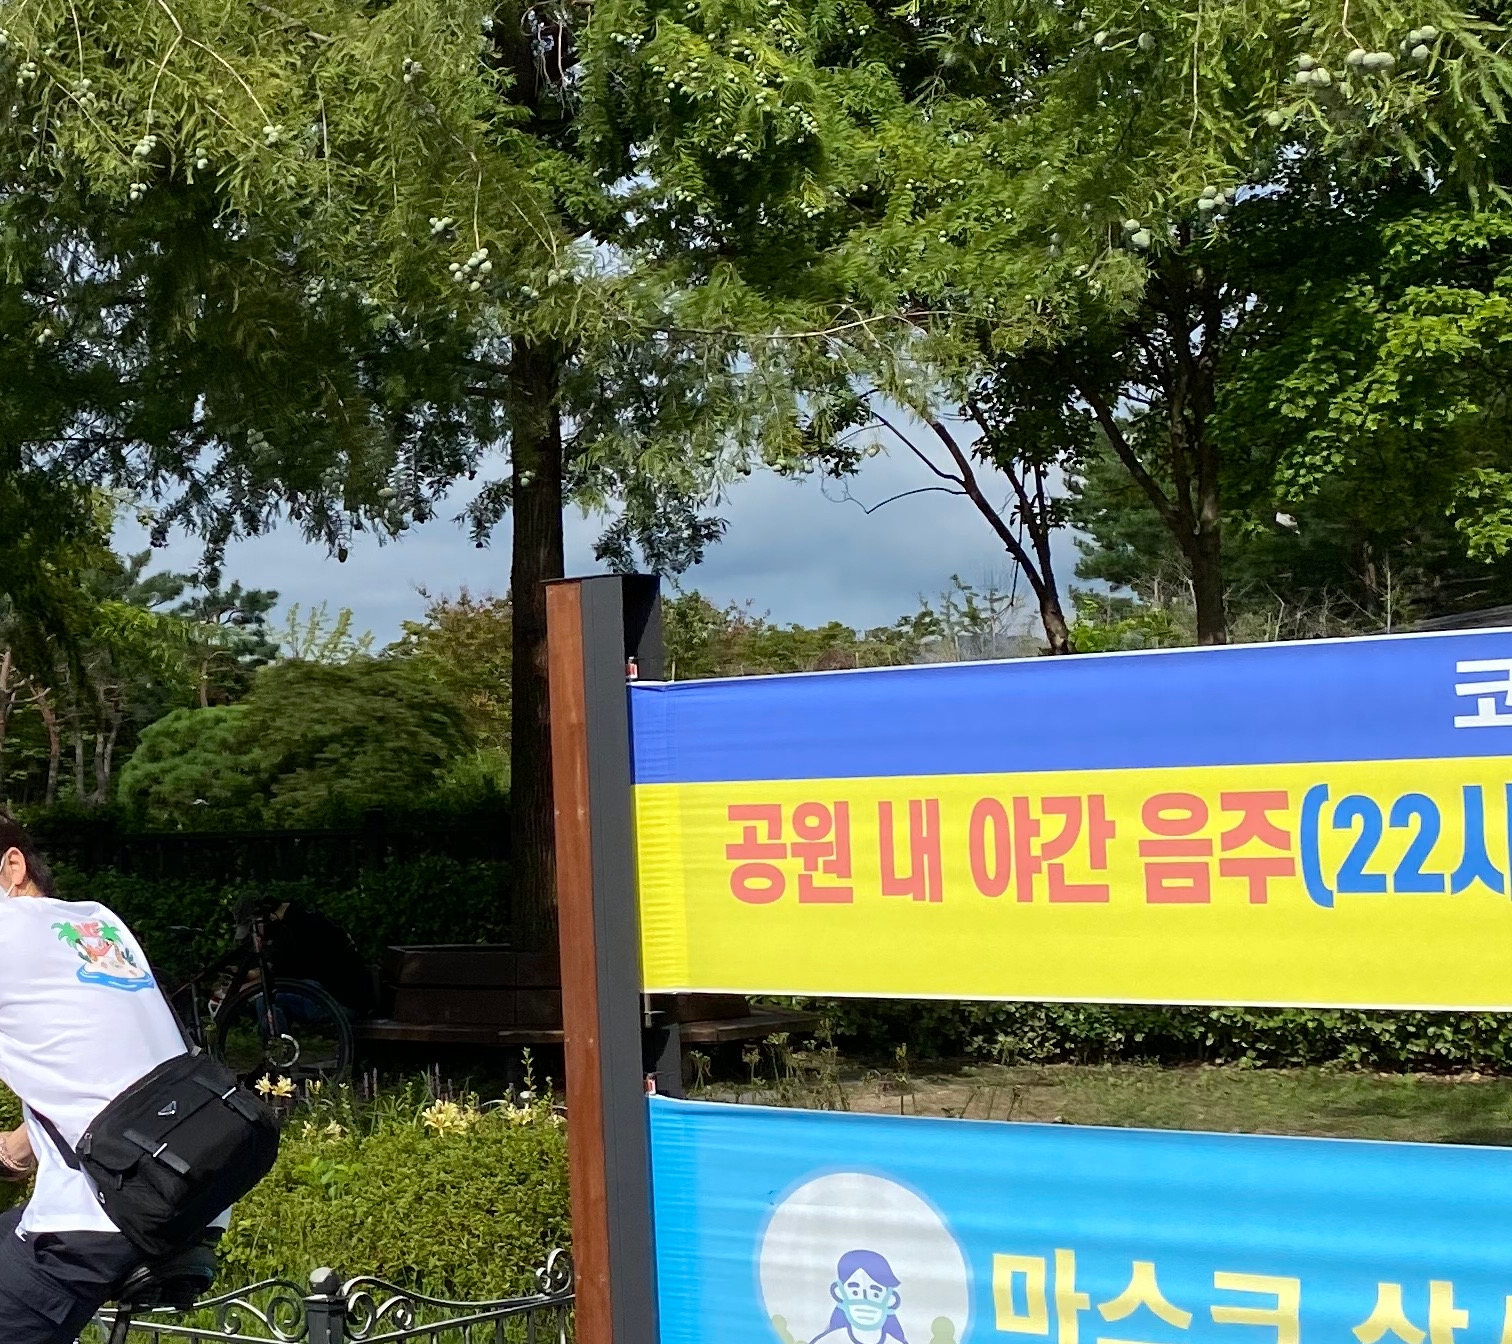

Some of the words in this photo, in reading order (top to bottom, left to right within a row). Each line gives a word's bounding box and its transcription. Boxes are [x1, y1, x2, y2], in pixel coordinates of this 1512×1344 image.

[725, 799, 855, 905] 공원
[878, 797, 944, 904] 내
[968, 793, 1117, 904] 야간
